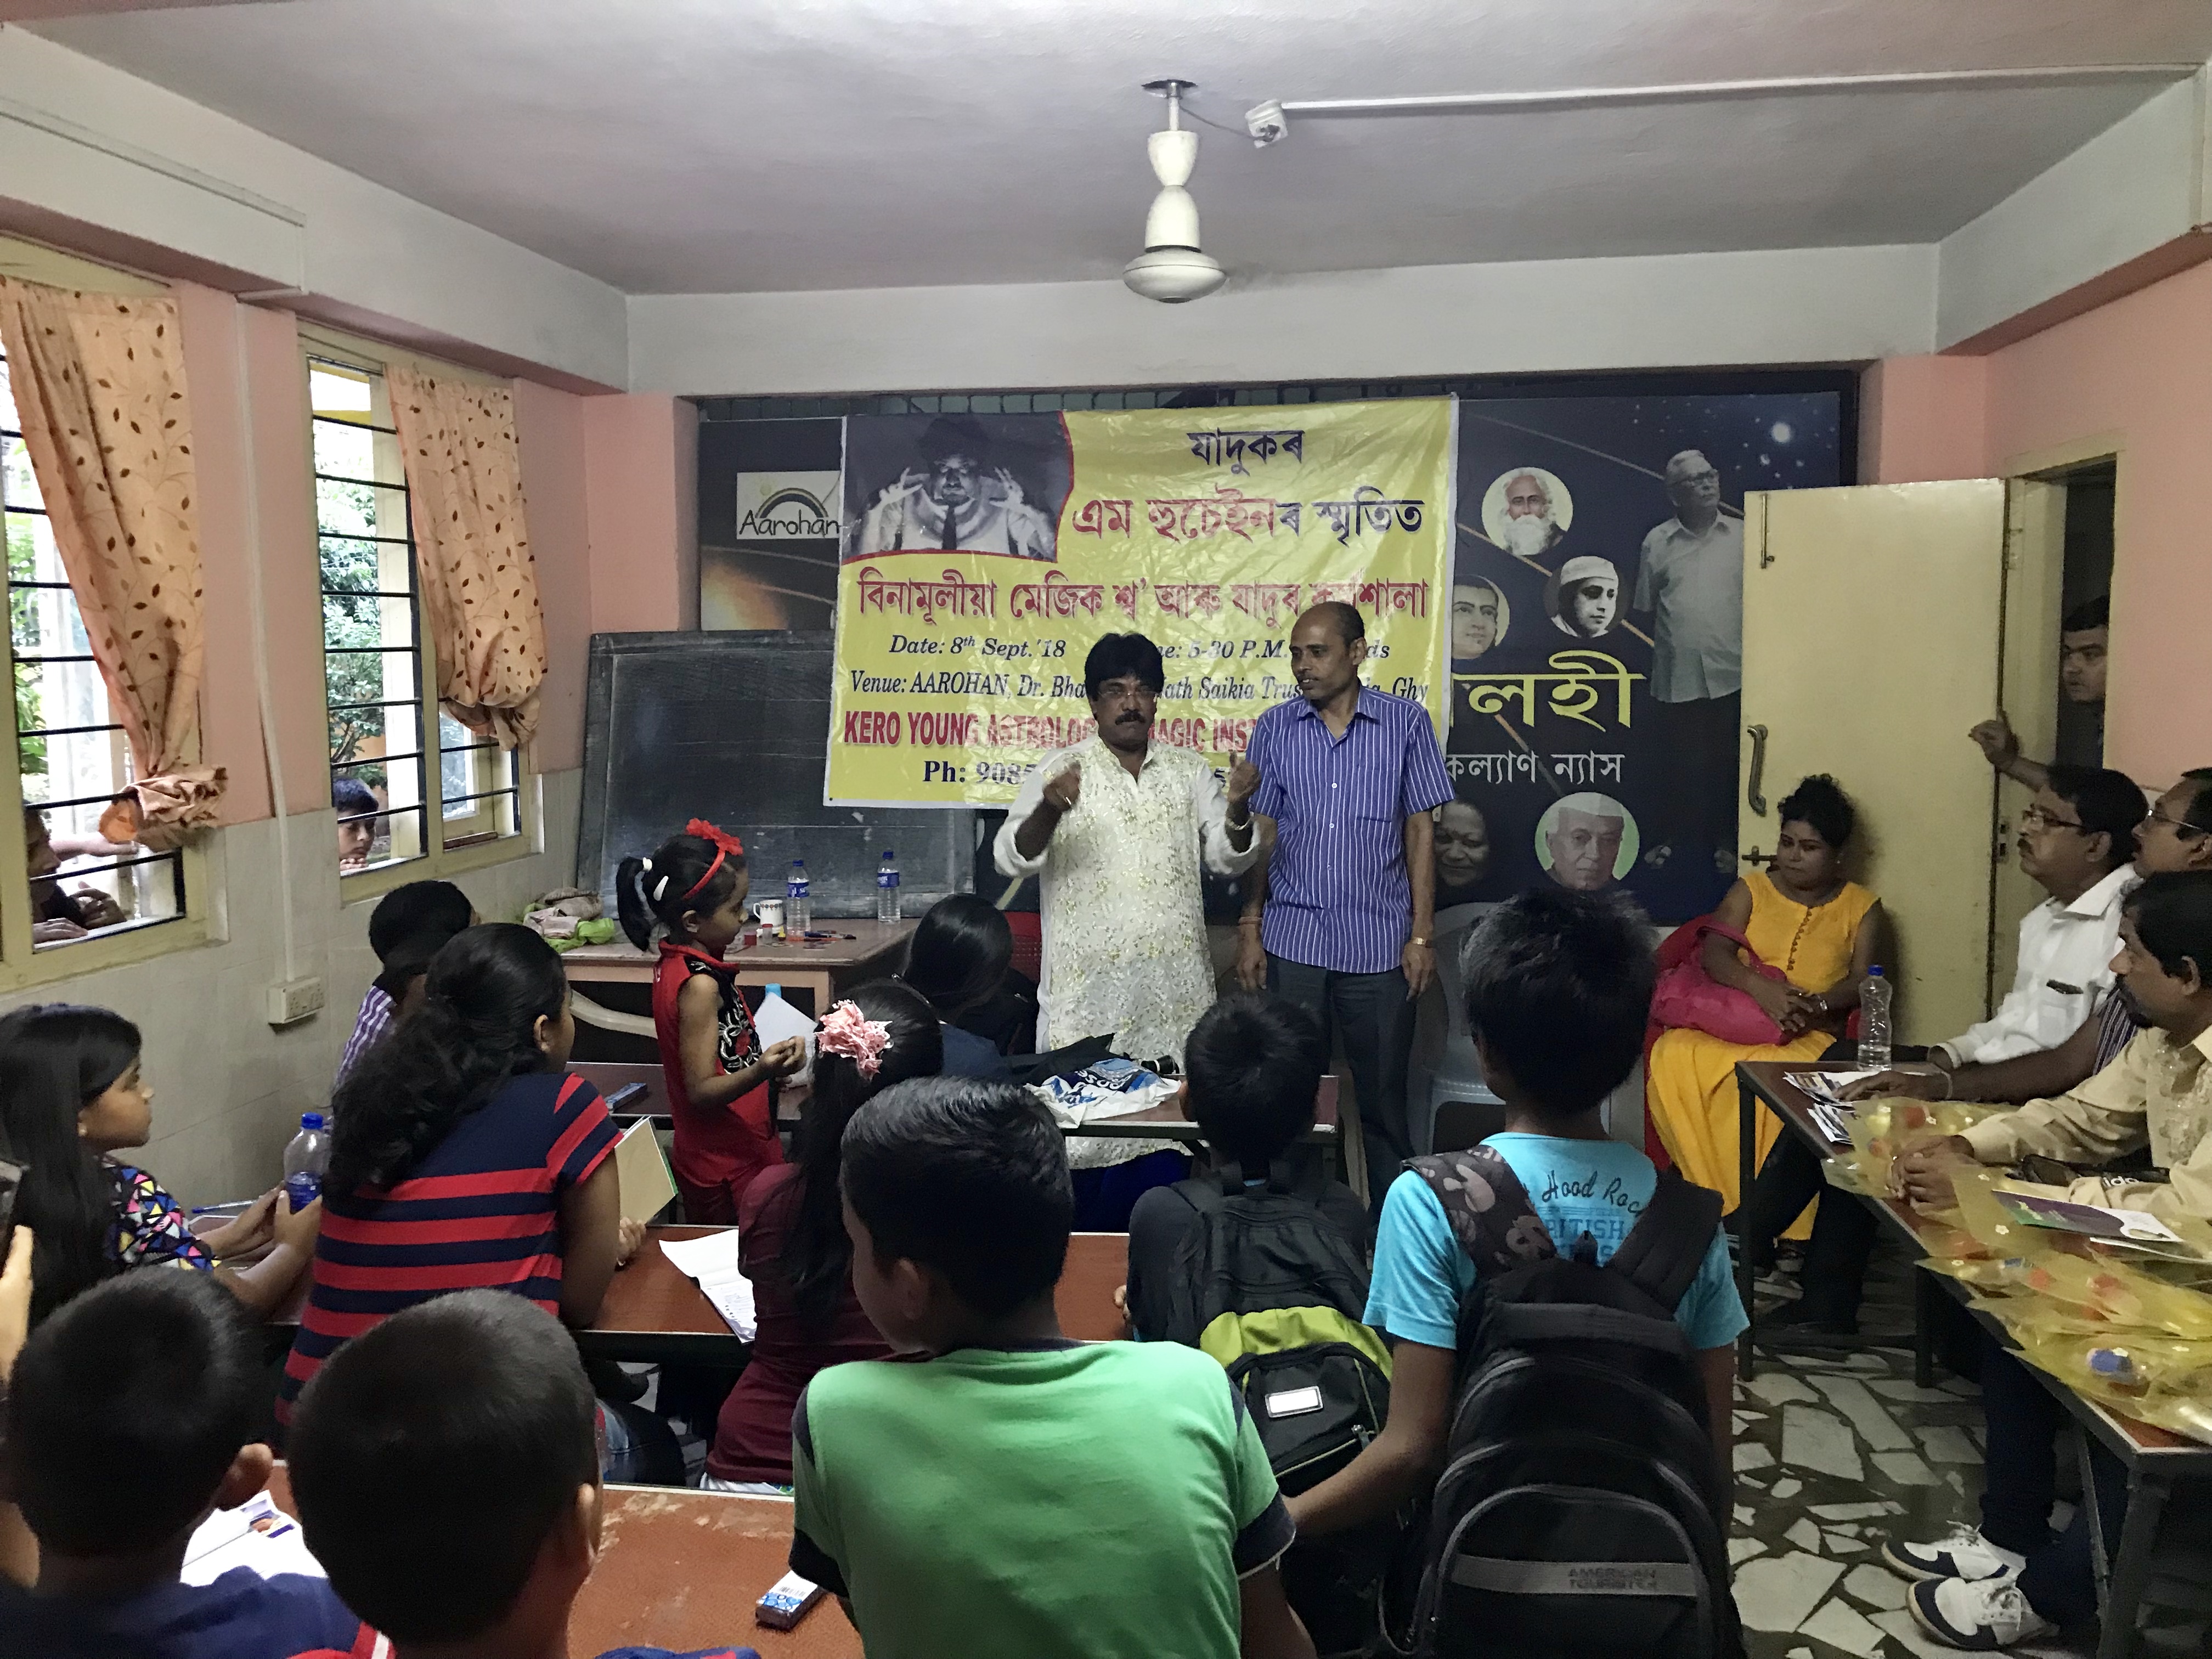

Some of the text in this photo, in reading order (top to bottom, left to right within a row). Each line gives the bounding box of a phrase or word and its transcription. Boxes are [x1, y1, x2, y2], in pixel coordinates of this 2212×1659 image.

[1186, 427, 1305, 477] যাদুকৰ
[739, 509, 840, 537] Aarohan
[1071, 500, 1133, 539] এম
[1311, 486, 1425, 548] স্মৃতিত
[856, 566, 997, 625] বিনামূলীয়া
[1010, 570, 1105, 619] মেজিক
[1153, 579, 1221, 620] আৰু
[1229, 579, 1301, 629] যাদুৰ
[889, 635, 945, 654] Date:
[950, 636, 976, 654] 8th
[1187, 640, 1234, 658] 5-30
[1239, 639, 1288, 658] P.M.
[851, 670, 907, 693] Venue:
[1017, 674, 1044, 697] Dr.
[1160, 676, 1193, 699] ath
[1198, 675, 1255, 699] Saikia
[1261, 675, 1304, 699] Trus
[844, 710, 901, 745] KERO
[907, 712, 979, 747] YOUNG
[923, 760, 966, 782] Ph:
[1550, 749, 1626, 785] ন্যাস
[1542, 1169, 1644, 1216] Hood Roc
[1544, 1218, 1625, 1240] RITISH
